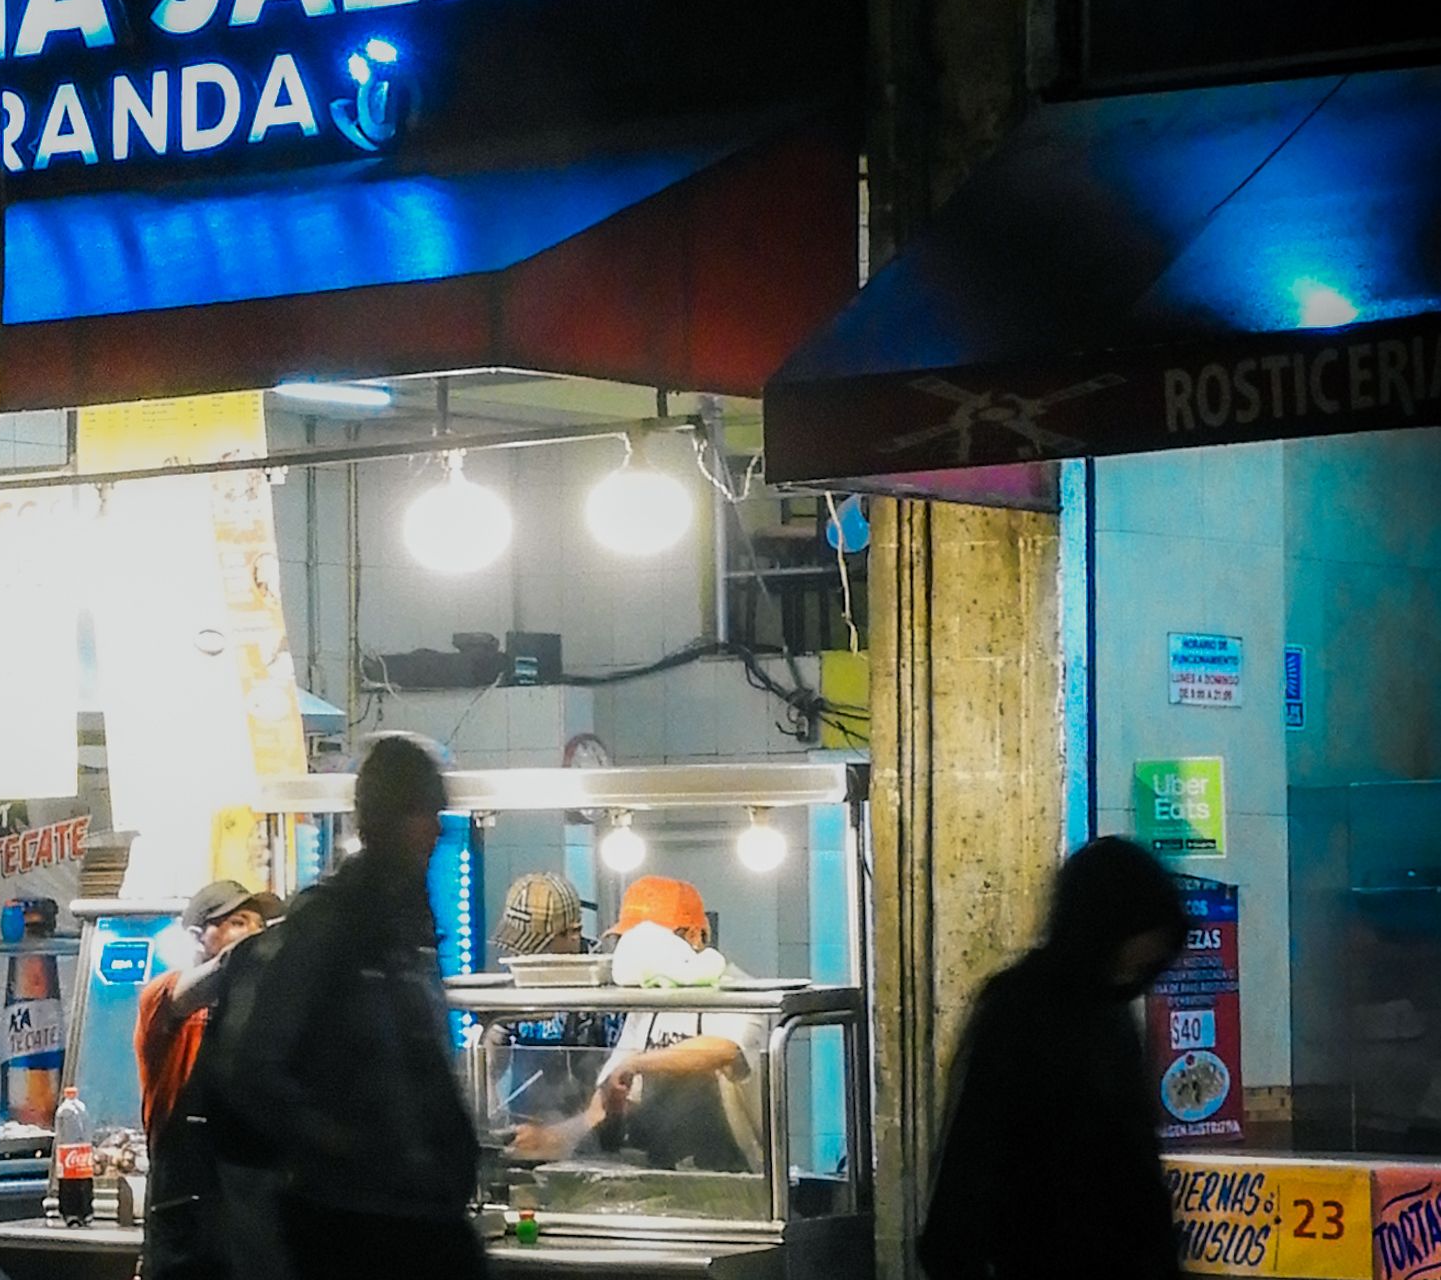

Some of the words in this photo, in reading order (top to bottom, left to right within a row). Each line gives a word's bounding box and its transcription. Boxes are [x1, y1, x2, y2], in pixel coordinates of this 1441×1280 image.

[1152, 774, 1209, 796] Uber
[1154, 798, 1210, 820] Eats
[1171, 1014, 1202, 1045] $40
[1293, 1199, 1345, 1240] 23
